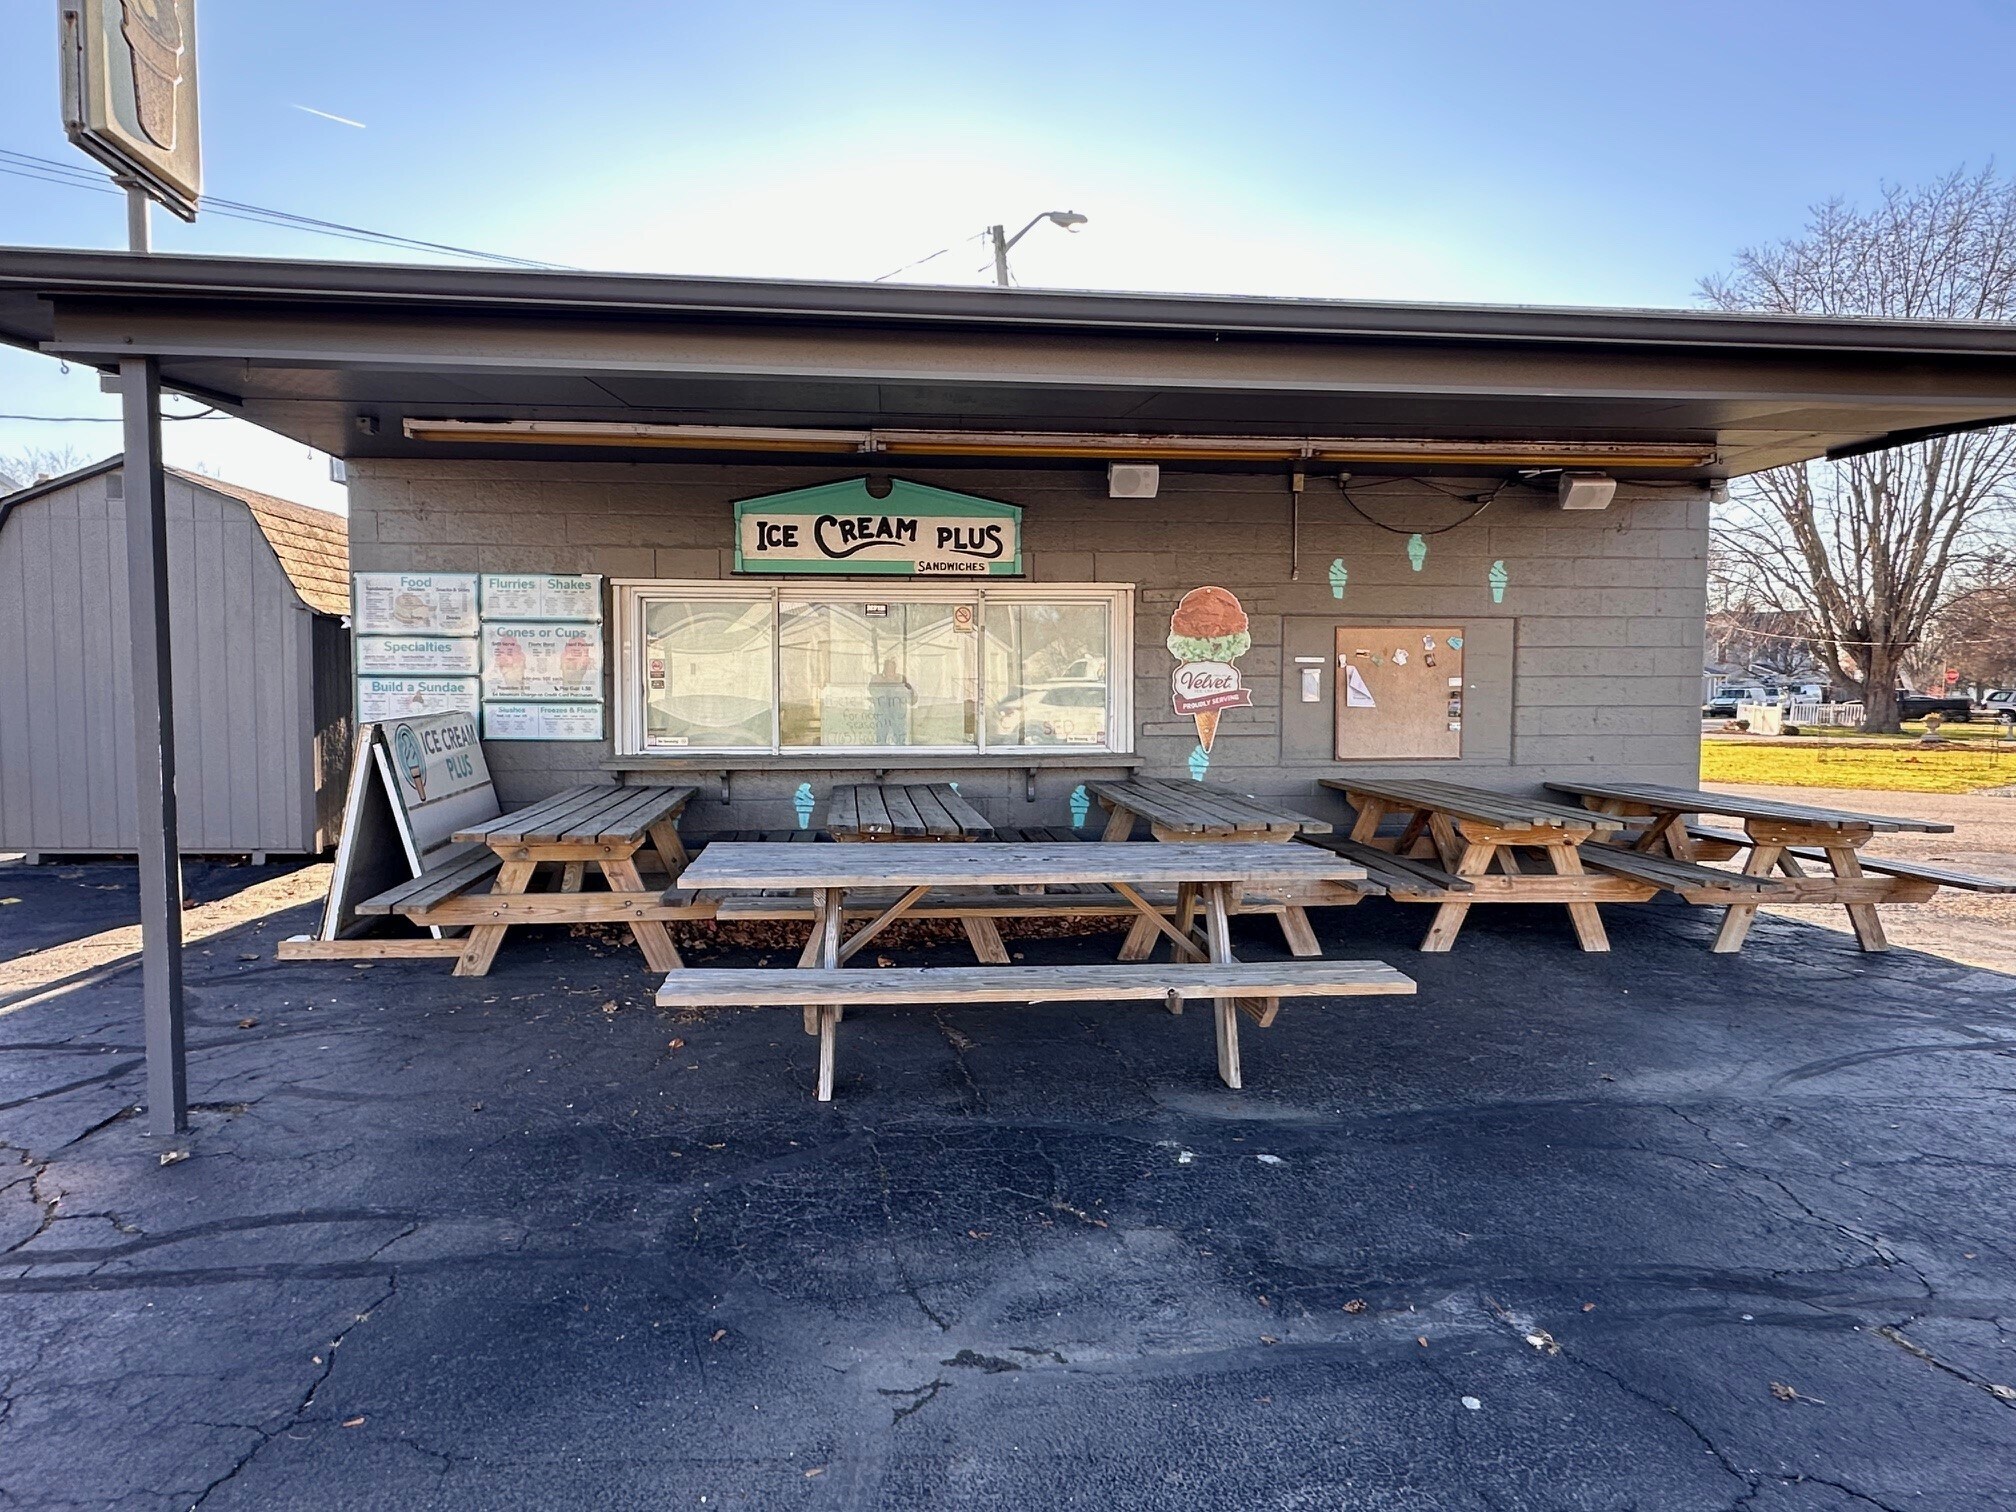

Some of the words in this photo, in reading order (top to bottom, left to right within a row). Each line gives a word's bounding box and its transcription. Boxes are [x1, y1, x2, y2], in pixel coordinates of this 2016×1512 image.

[757, 521, 798, 551] ICE
[814, 515, 918, 558] CREAM
[937, 525, 1003, 558] PLUS
[918, 561, 985, 572] SANDWICHES
[401, 577, 432, 588] Food
[490, 578, 535, 589] Flurries
[548, 579, 592, 590] Shakes
[497, 627, 535, 638] Cones
[539, 629, 551, 638] or
[555, 627, 587, 640] Cups
[384, 641, 452, 653] Specialties
[1181, 671, 1233, 689] Velvet
[372, 682, 403, 692] Build
[407, 684, 414, 692] a
[418, 682, 466, 692] Sundae
[1182, 700, 1211, 710] PROUDLY
[1212, 694, 1240, 705] SERVING
[420, 730, 442, 755] ICE
[441, 724, 478, 750] CREAM
[446, 754, 473, 781] PLUS
